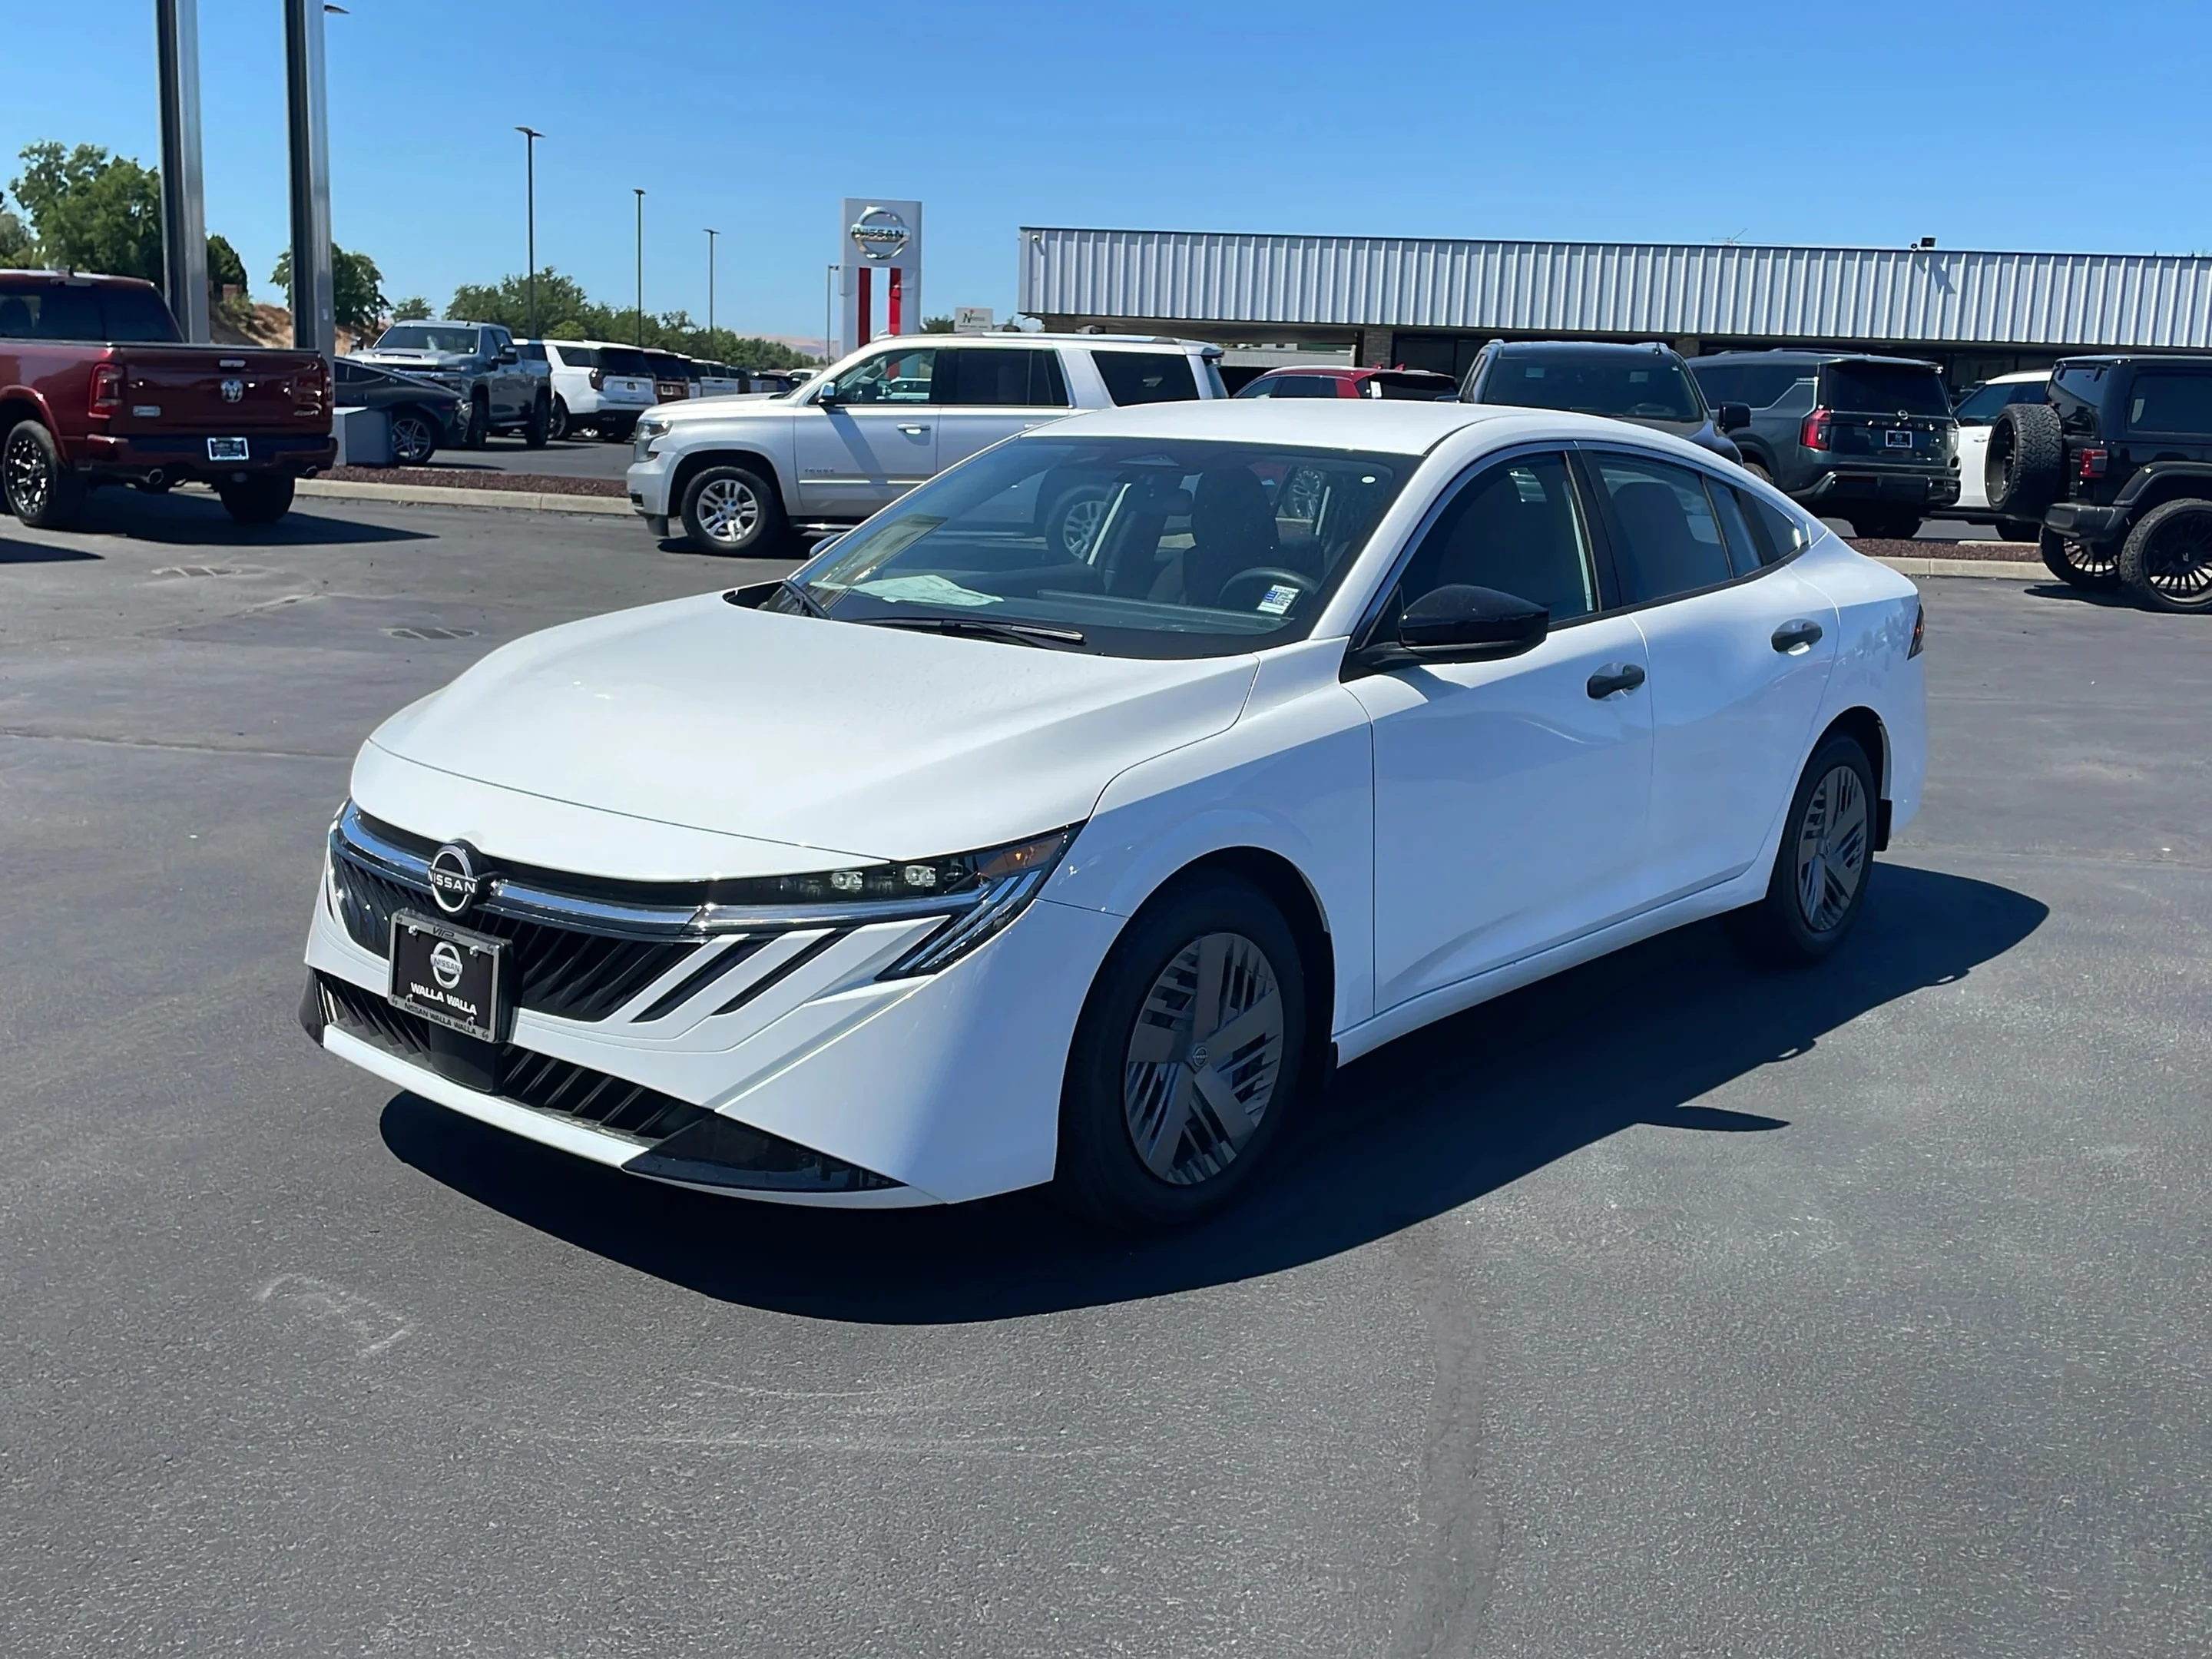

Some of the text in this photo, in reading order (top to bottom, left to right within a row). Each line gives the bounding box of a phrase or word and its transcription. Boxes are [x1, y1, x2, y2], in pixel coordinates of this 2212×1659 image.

[428, 869, 475, 893] NISSAN
[434, 958, 460, 973] NISSAN
[410, 982, 477, 1015] WALLA WALLA
[404, 1002, 476, 1035] NISSAN WALLA WALLA
